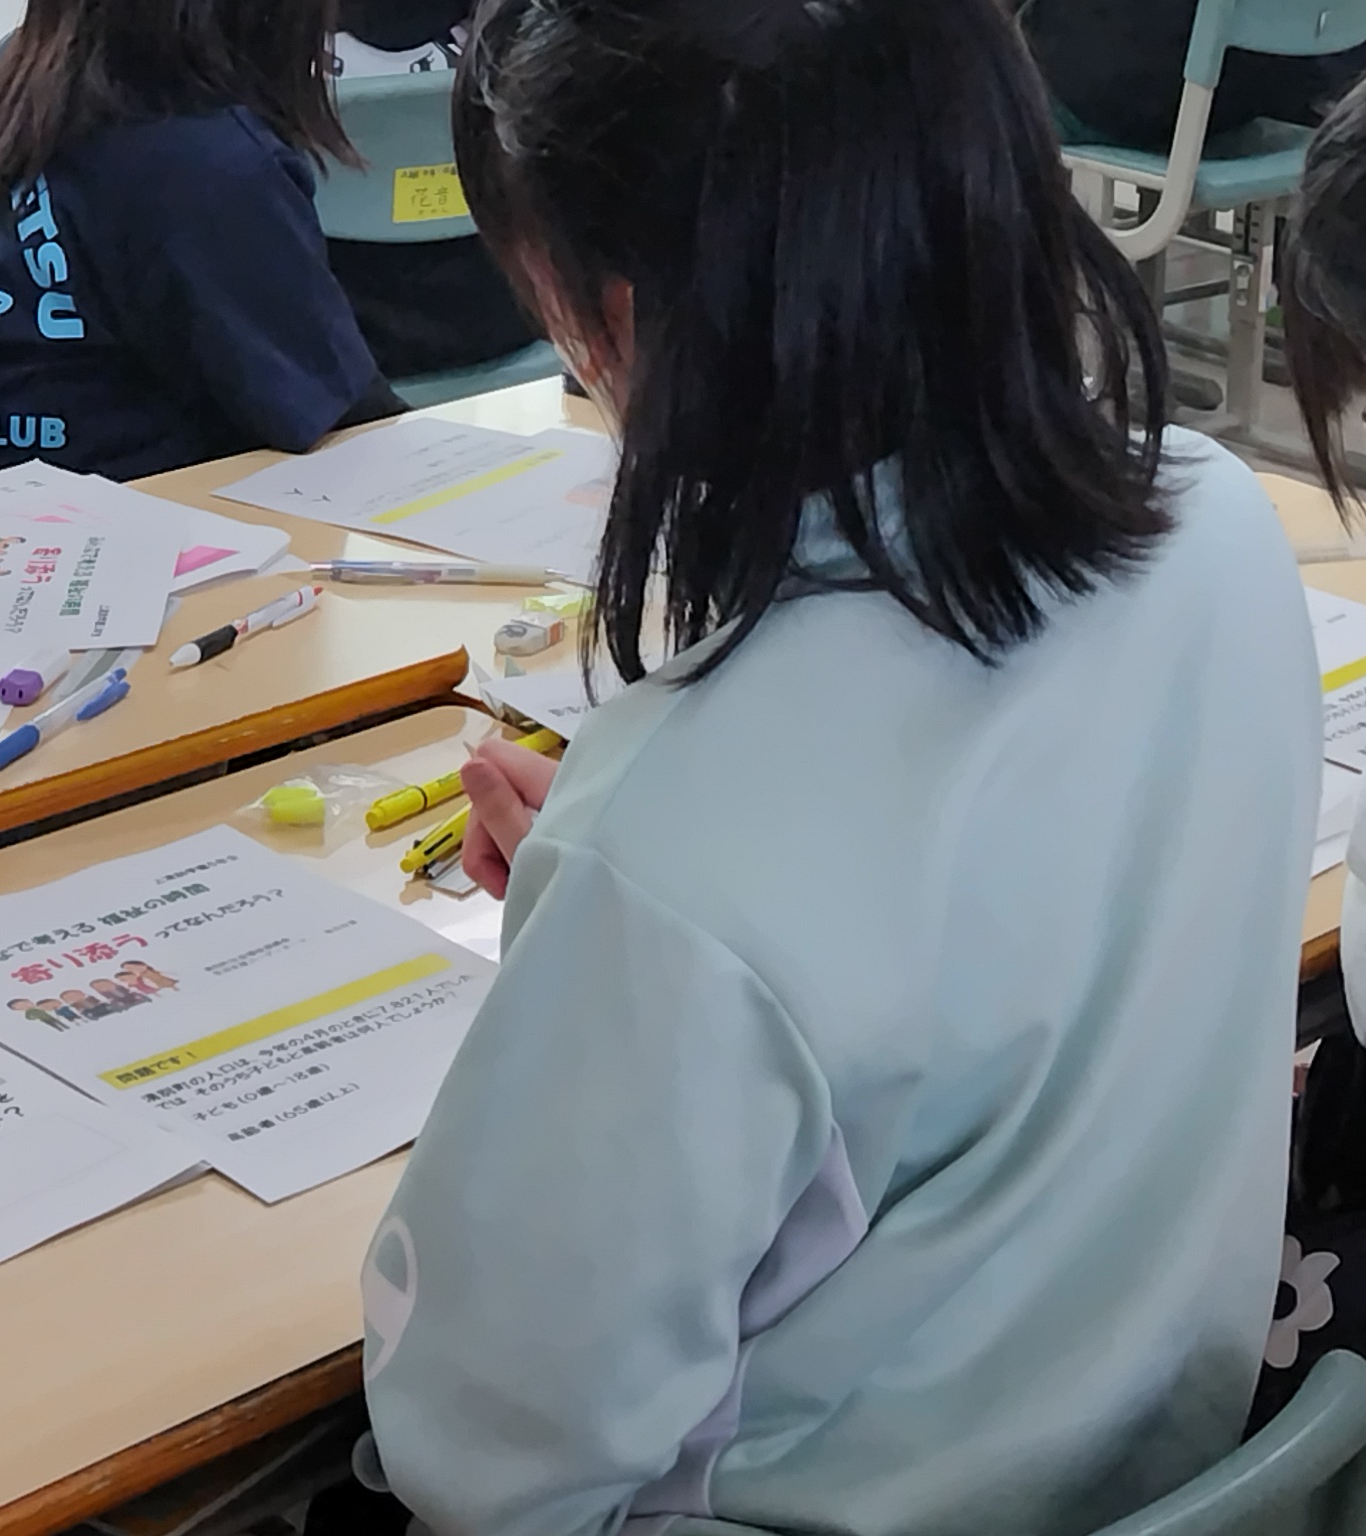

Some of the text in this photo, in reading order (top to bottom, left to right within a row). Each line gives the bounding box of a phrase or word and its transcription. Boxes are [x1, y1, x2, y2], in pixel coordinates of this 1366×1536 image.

[96, 882, 211, 927] 福祉の時間
[10, 933, 150, 985] 寄り添う
[154, 888, 286, 940] ってなんだろう?
[115, 1051, 198, 1085] 問題です!
